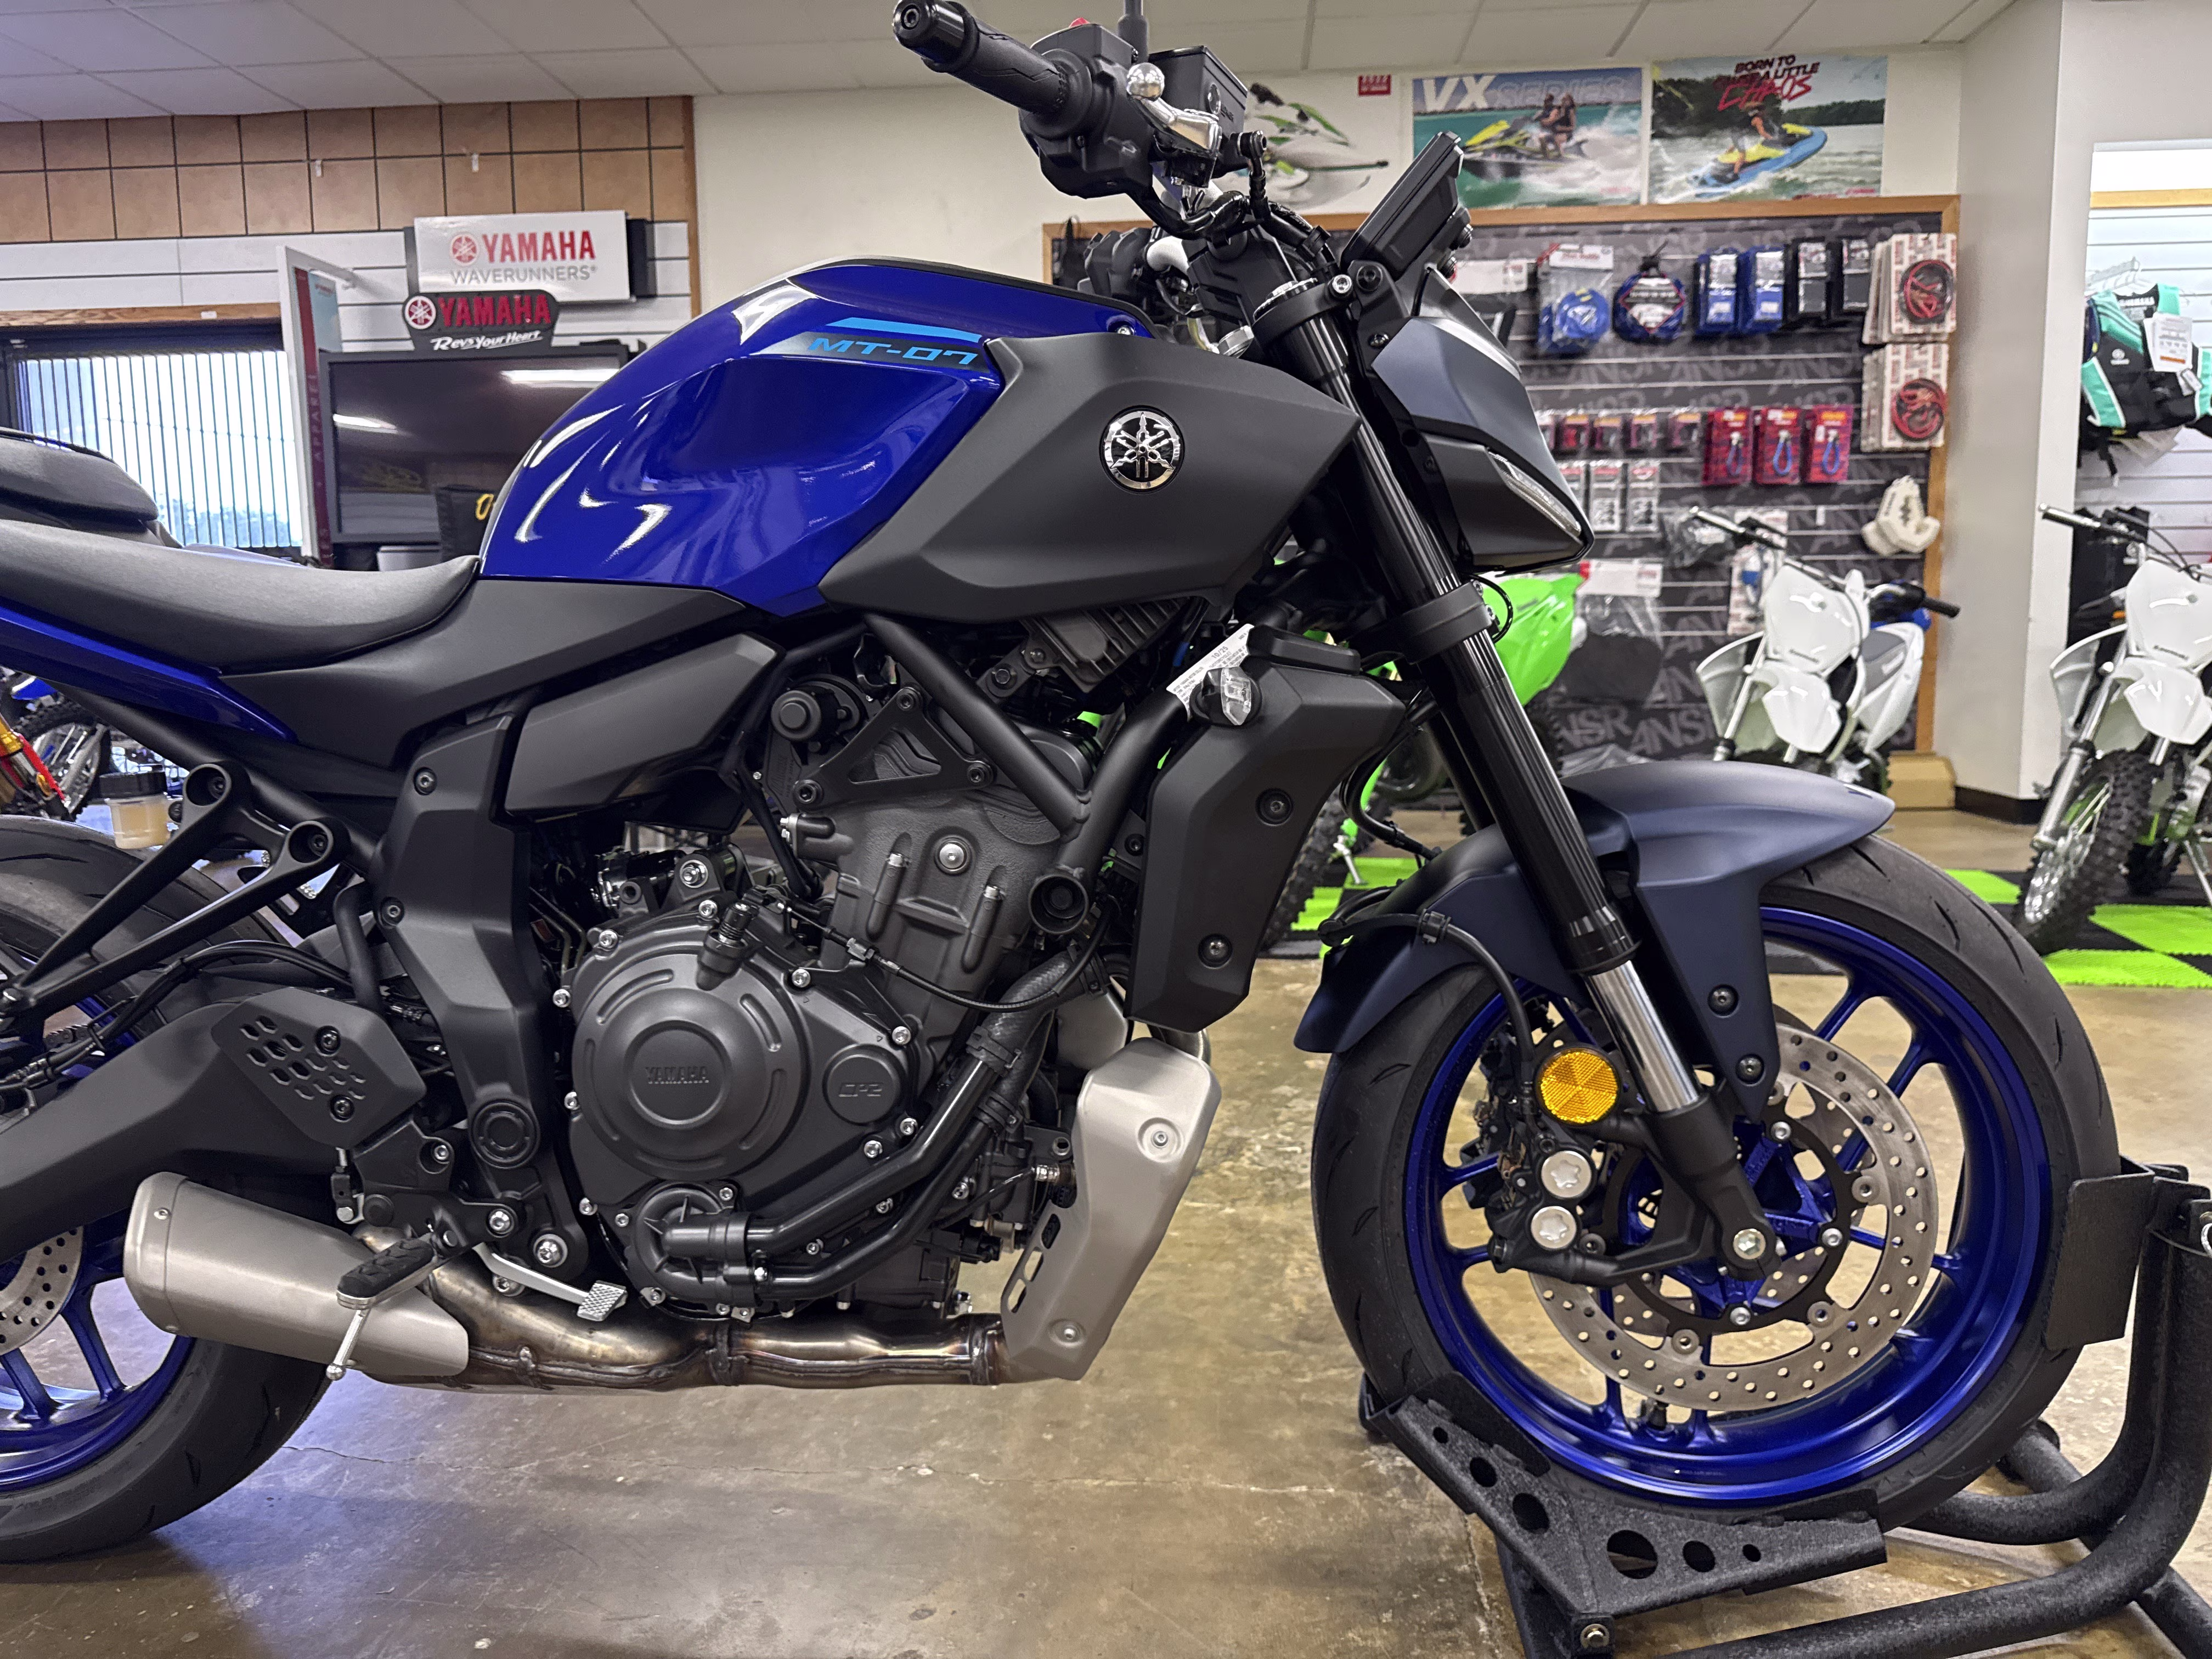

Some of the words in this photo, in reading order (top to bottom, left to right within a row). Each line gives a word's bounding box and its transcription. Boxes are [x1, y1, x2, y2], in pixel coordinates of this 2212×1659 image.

[1778, 54, 1796, 67] TO
[1774, 62, 1821, 80] LITTLE
[1421, 75, 1497, 111] VX
[482, 230, 596, 263] YAMAHA
[439, 295, 551, 327] YAMAHA
[476, 335, 506, 349] Your
[808, 338, 979, 365] MT-07
[1211, 646, 1229, 659] 10/25
[645, 1066, 710, 1085] YAMAHA
[838, 1082, 884, 1097] CP2
